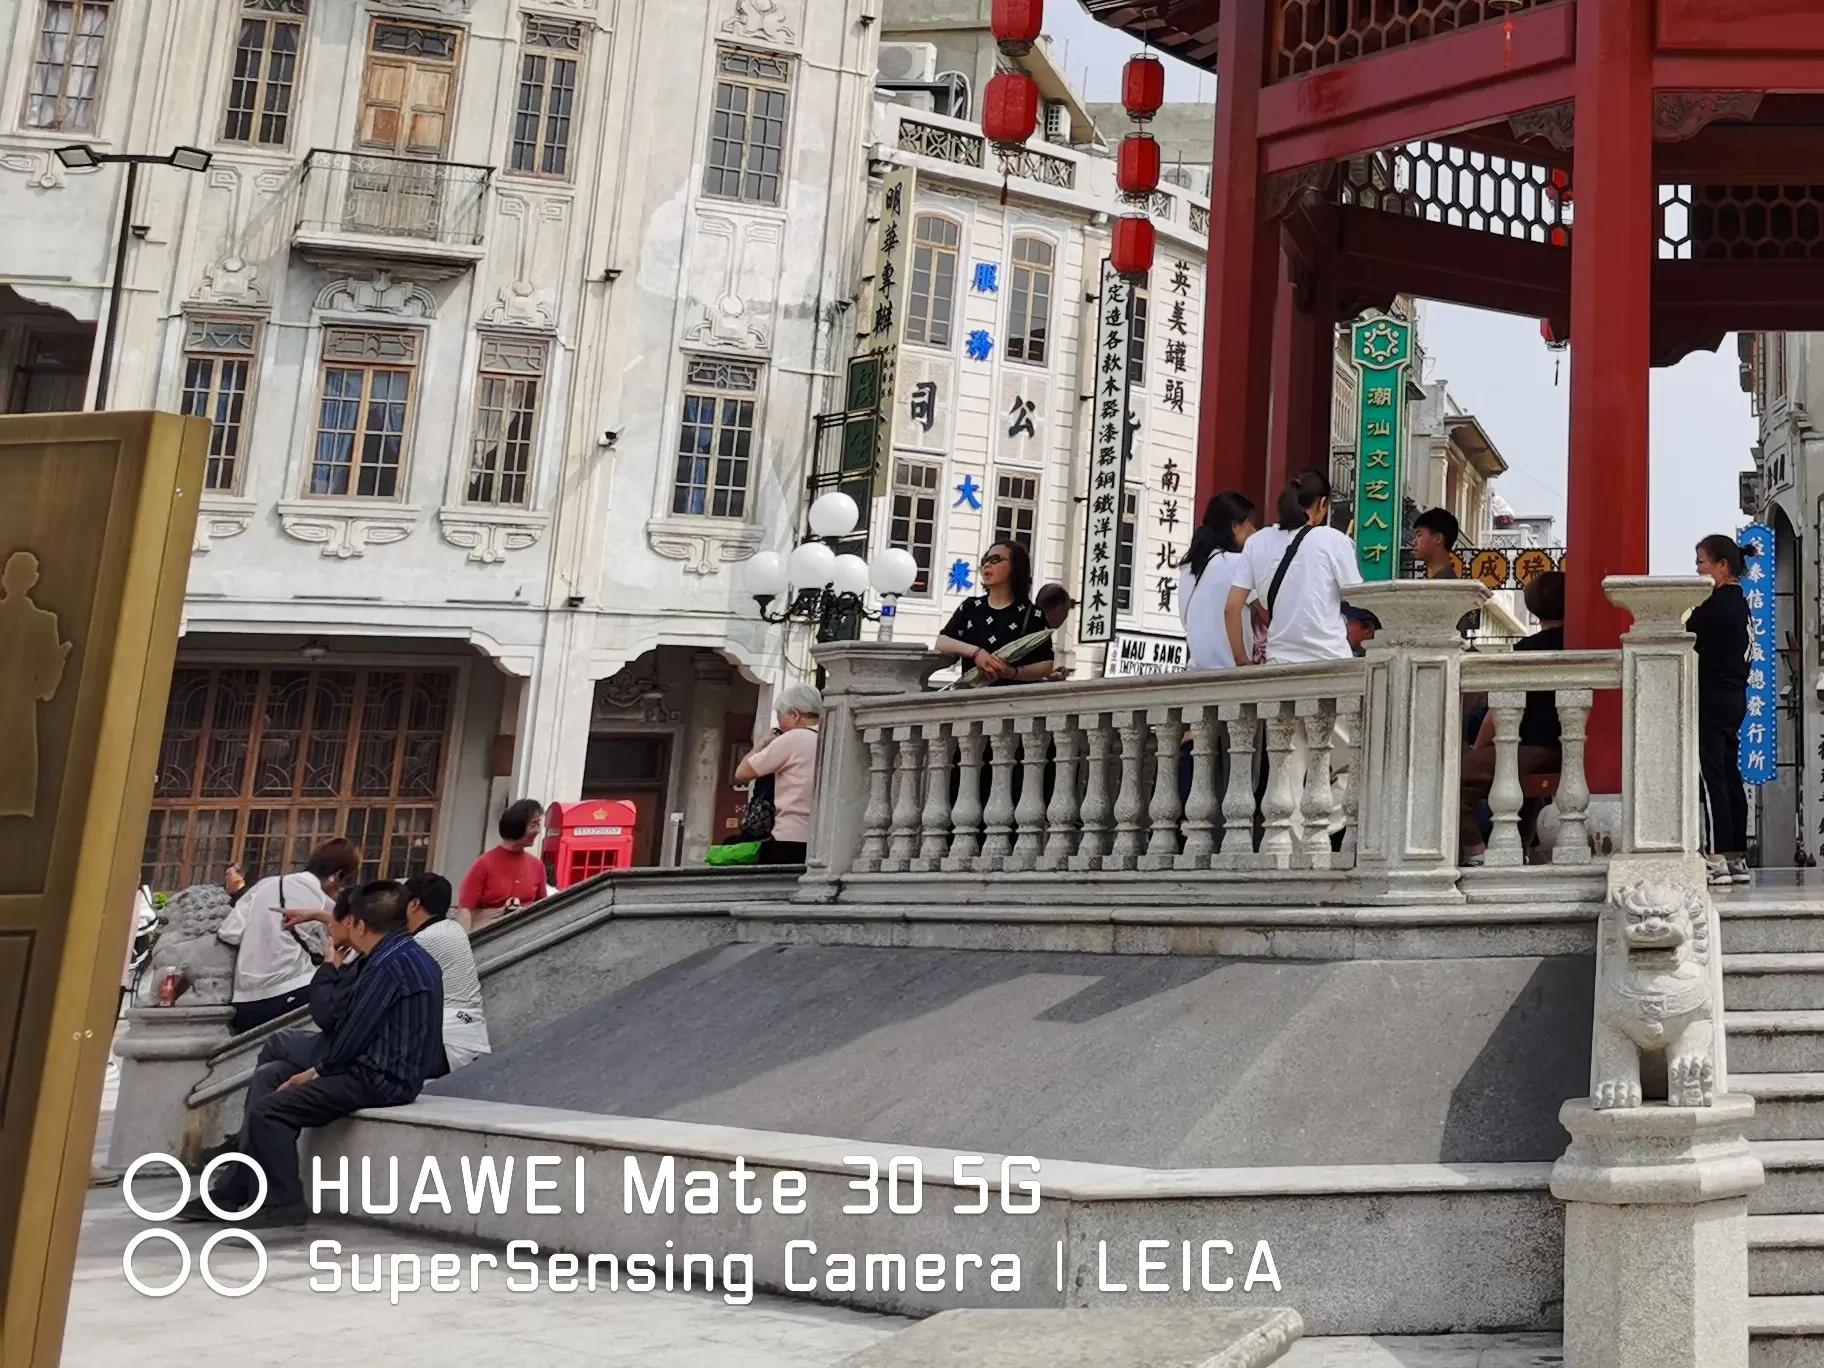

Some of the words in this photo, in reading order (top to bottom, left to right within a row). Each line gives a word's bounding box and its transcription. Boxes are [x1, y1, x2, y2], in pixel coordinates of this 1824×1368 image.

[1162, 260, 1191, 414] 英美罐頭
[1155, 457, 1181, 613] 南洋北貨
[1361, 386, 1393, 564] 潮汕文艺人才
[1121, 639, 1146, 660] MAU
[1153, 643, 1182, 664] SANG
